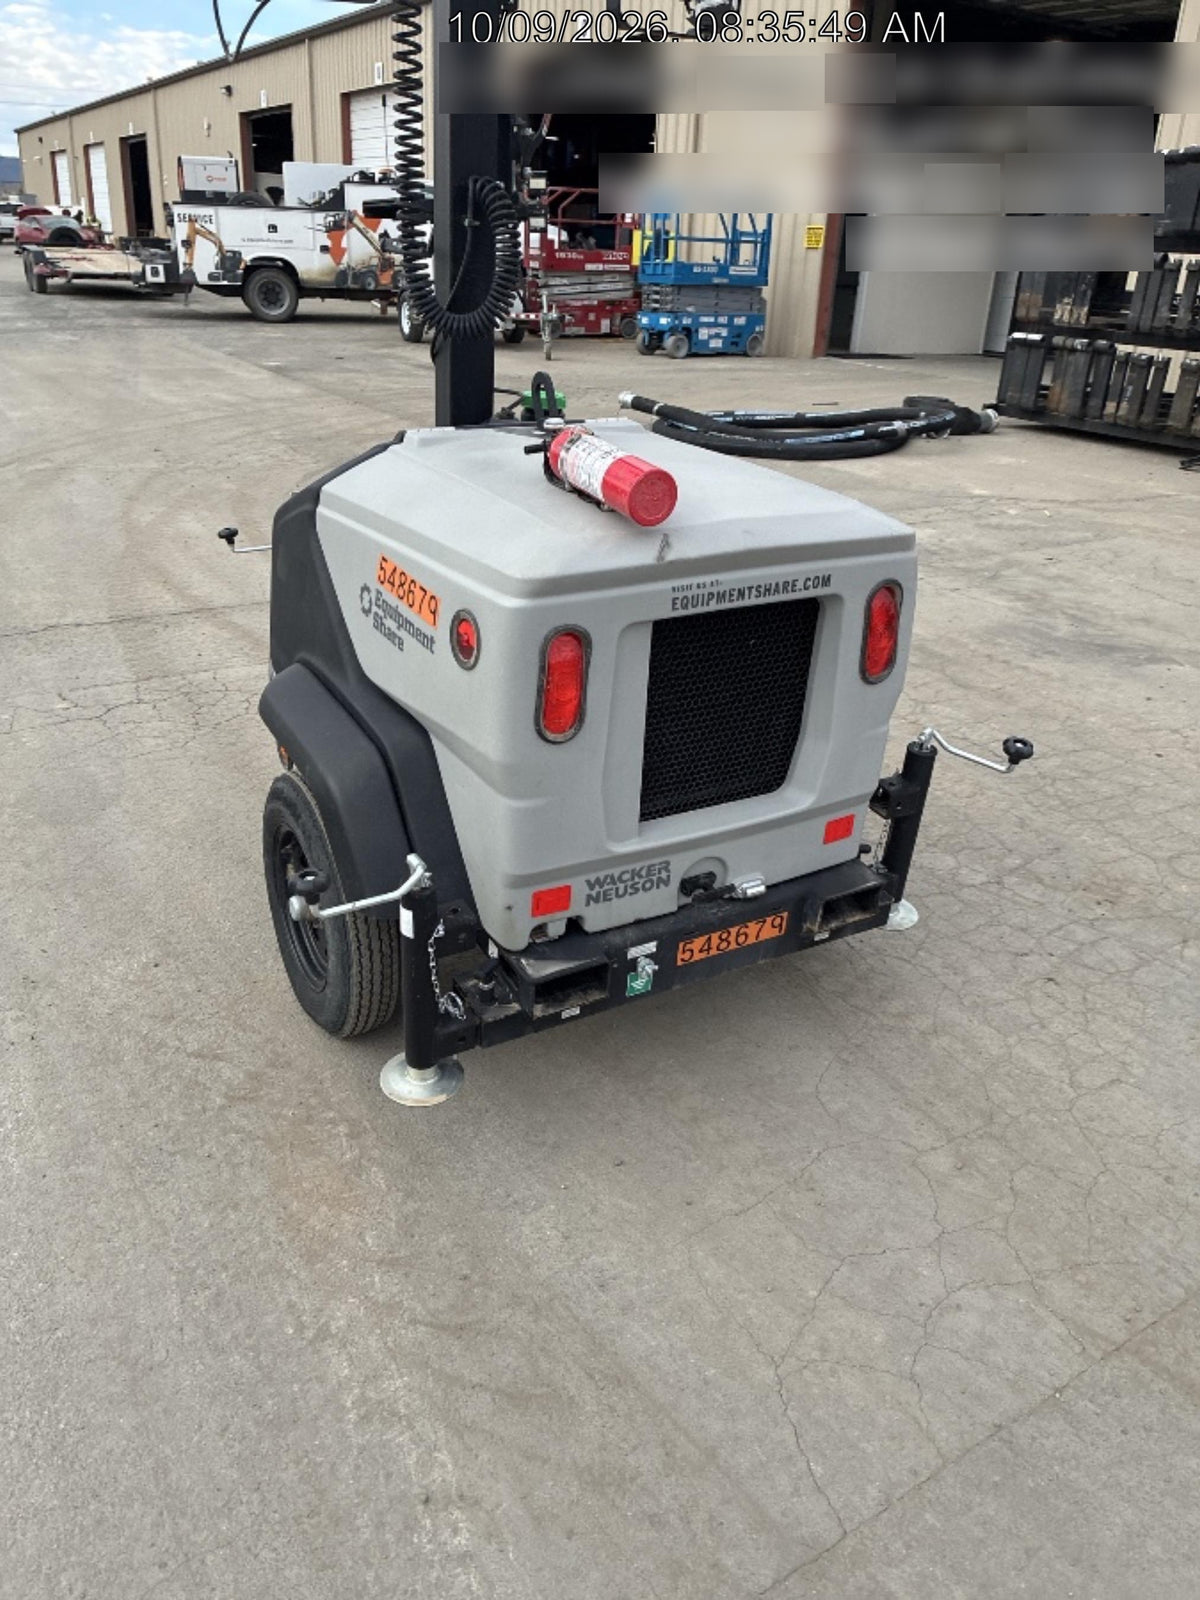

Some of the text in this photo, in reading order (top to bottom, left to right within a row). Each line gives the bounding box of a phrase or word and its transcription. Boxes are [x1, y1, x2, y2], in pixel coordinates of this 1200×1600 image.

[378, 555, 438, 627] 548679
[671, 574, 832, 612] EQUIPMENTSHARE.COM
[373, 611, 405, 652] Share
[375, 588, 436, 655] Equipment
[584, 860, 671, 891] WACKER
[584, 874, 671, 908] NEUSON
[680, 914, 784, 963] 548679
